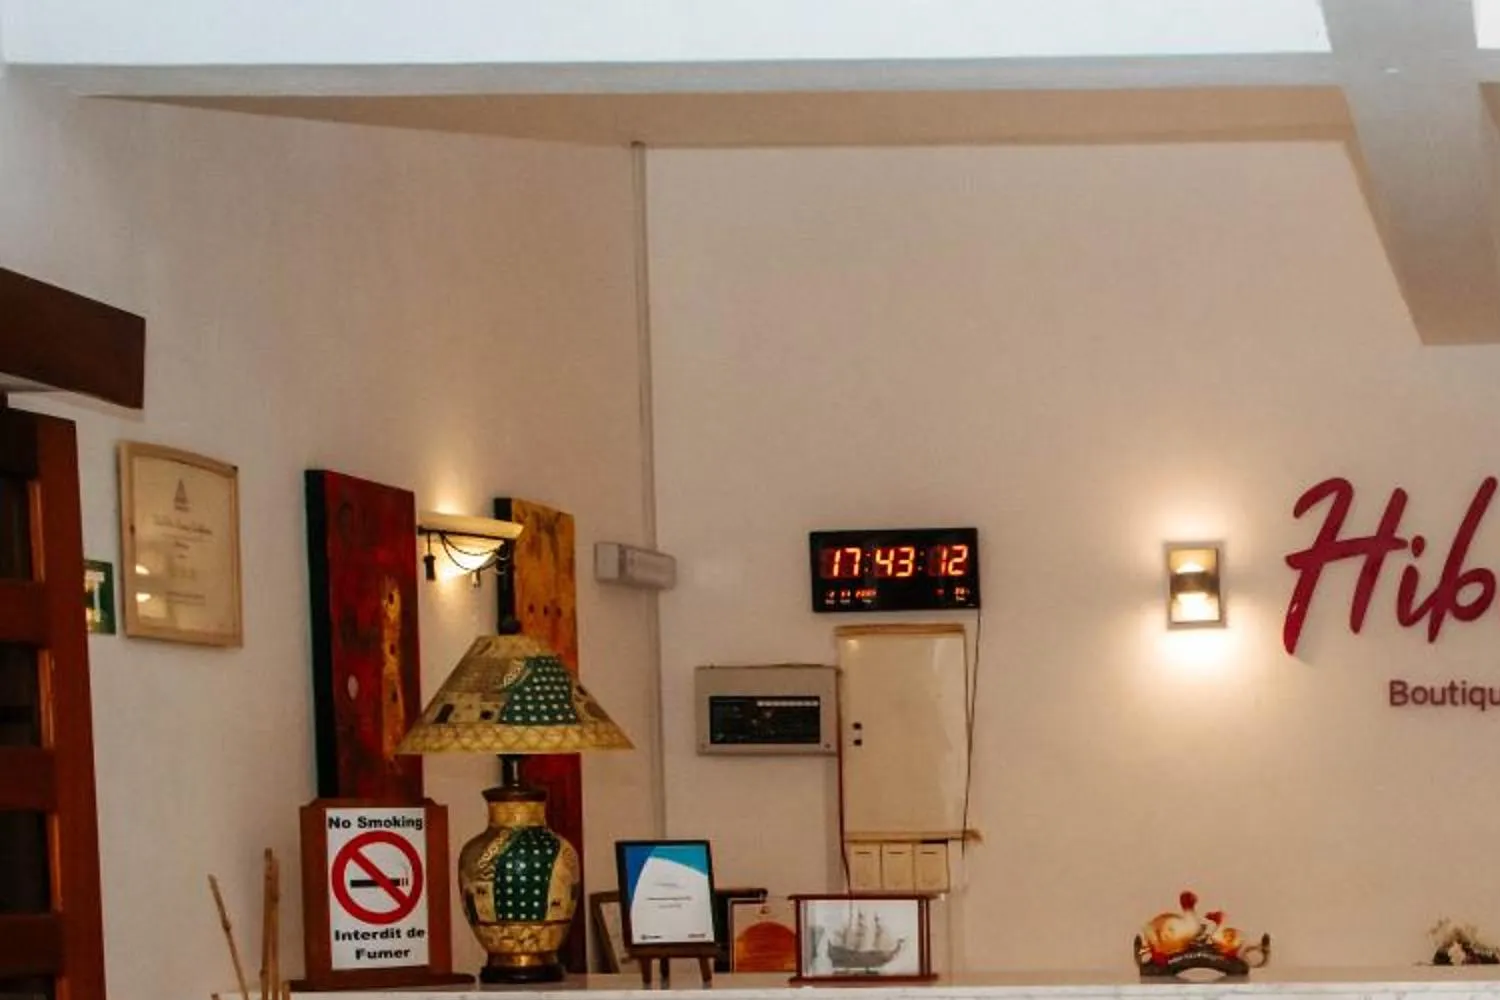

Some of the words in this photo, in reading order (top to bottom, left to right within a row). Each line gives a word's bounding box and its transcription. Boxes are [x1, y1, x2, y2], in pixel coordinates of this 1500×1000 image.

[328, 817, 351, 829] No
[357, 816, 423, 830] Smoking
[335, 928, 402, 941] Interdit
[407, 927, 425, 939] de
[355, 948, 411, 960] Fumer
